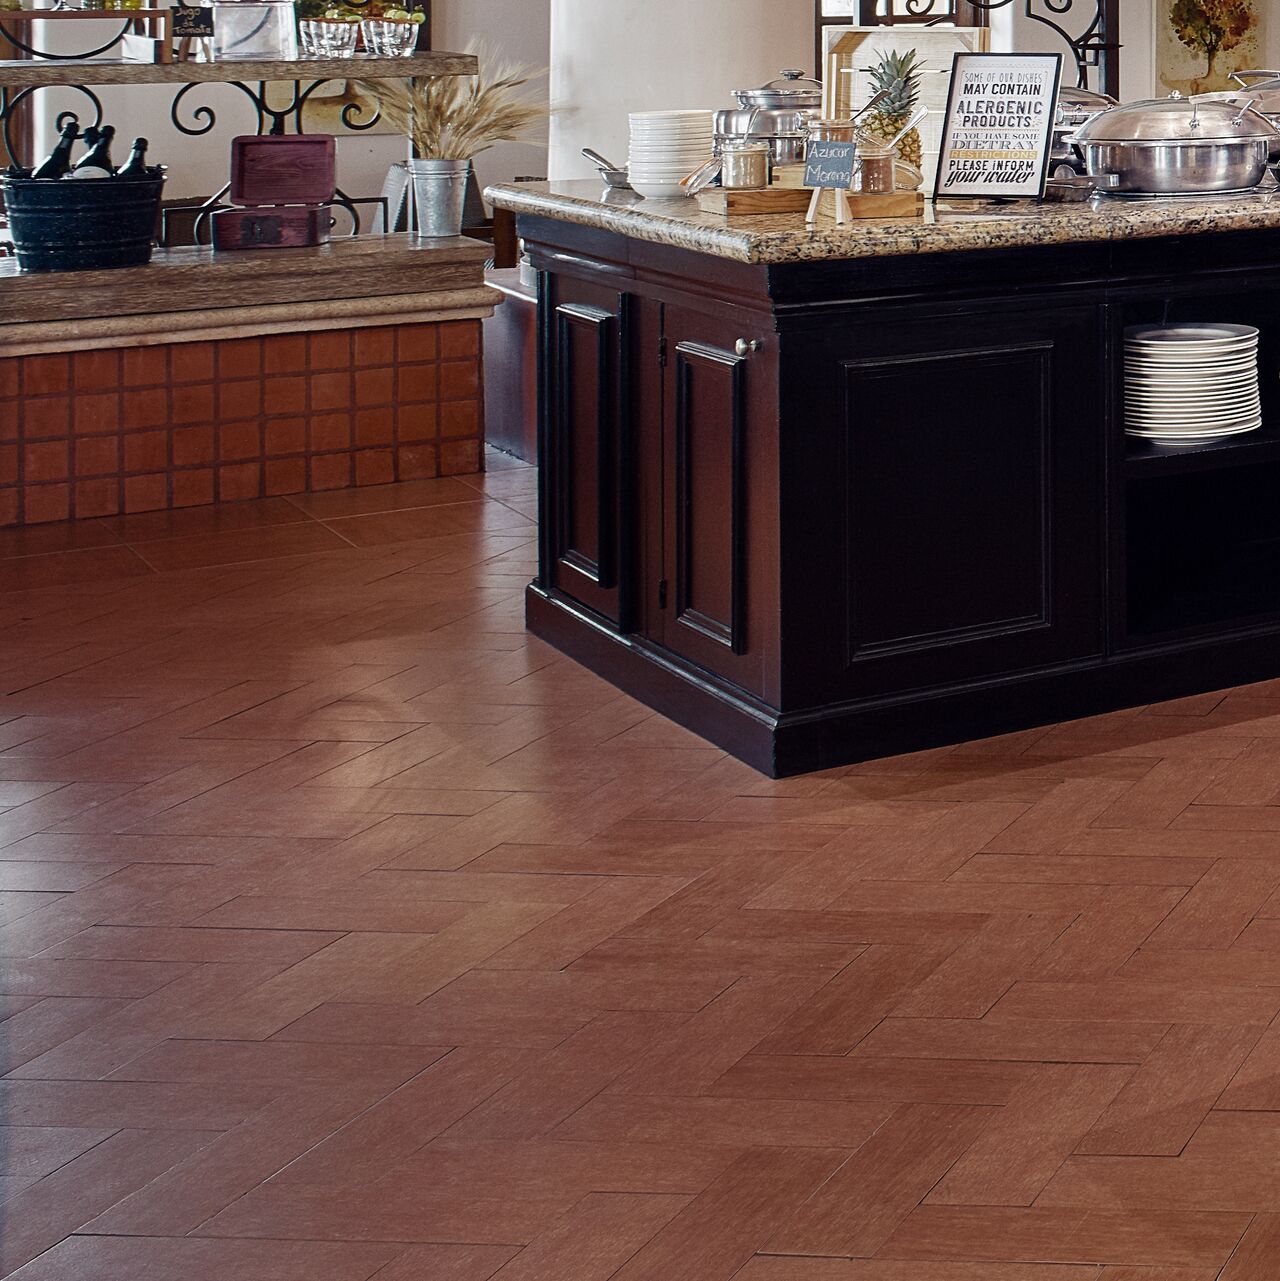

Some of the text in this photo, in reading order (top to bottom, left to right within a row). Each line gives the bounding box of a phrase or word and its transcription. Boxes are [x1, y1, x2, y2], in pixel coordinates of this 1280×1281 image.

[965, 72, 1042, 83] SOME OF OUR DISHES
[963, 84, 1041, 95] MAY CONTAIN
[957, 100, 1043, 115] ALERGENIC
[962, 115, 1032, 127] PRODUCTS
[951, 151, 1036, 159] RESTRICTIONS
[949, 160, 989, 171] PLEASE
[944, 170, 985, 187] your
